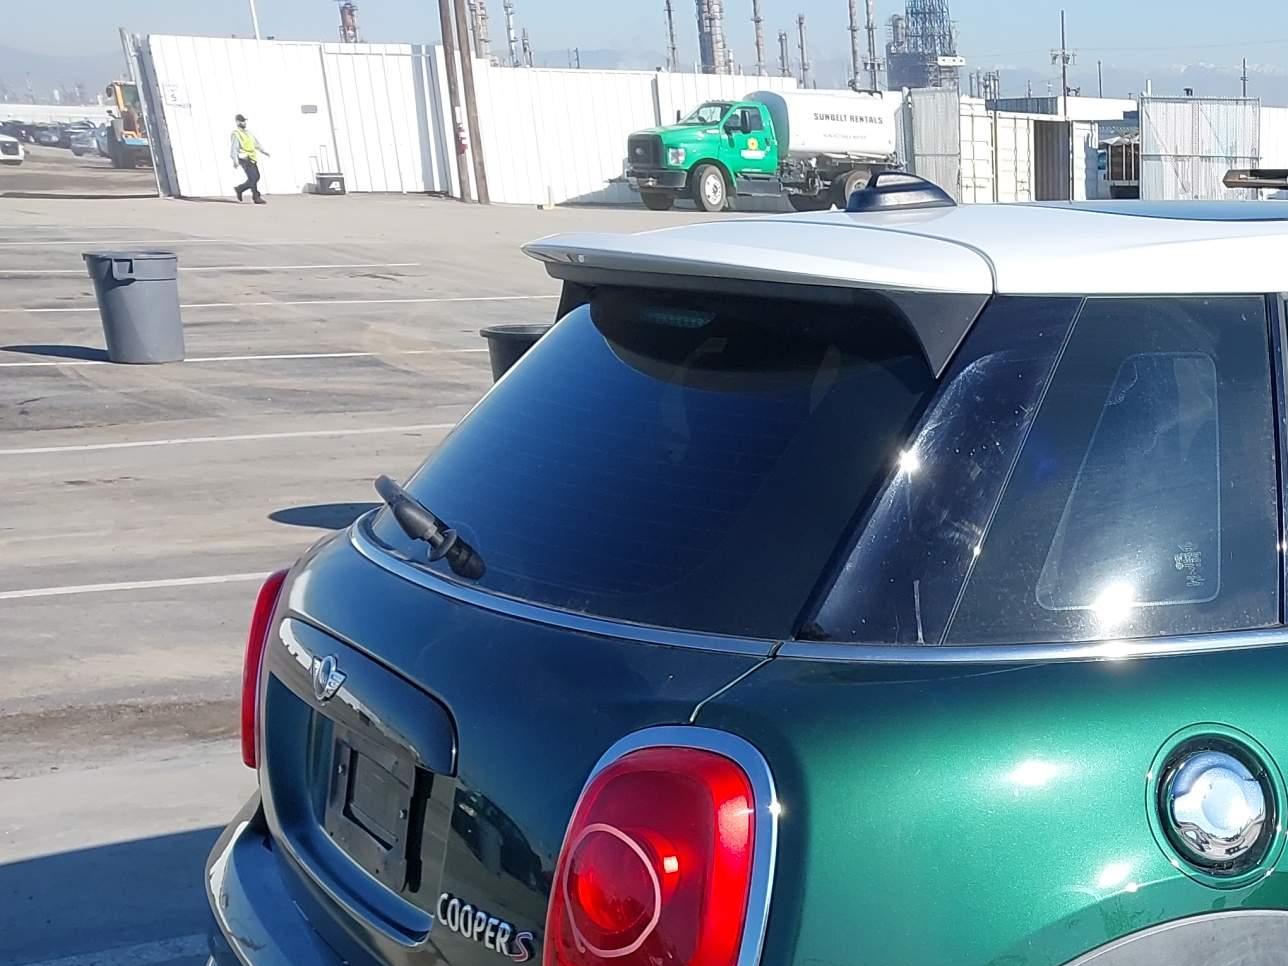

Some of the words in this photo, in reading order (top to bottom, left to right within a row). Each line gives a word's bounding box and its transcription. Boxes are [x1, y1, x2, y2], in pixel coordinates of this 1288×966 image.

[813, 112, 848, 122] SUNBELT
[849, 114, 884, 125] RENTALS
[437, 893, 512, 956] COOPER
[507, 931, 534, 963] S
